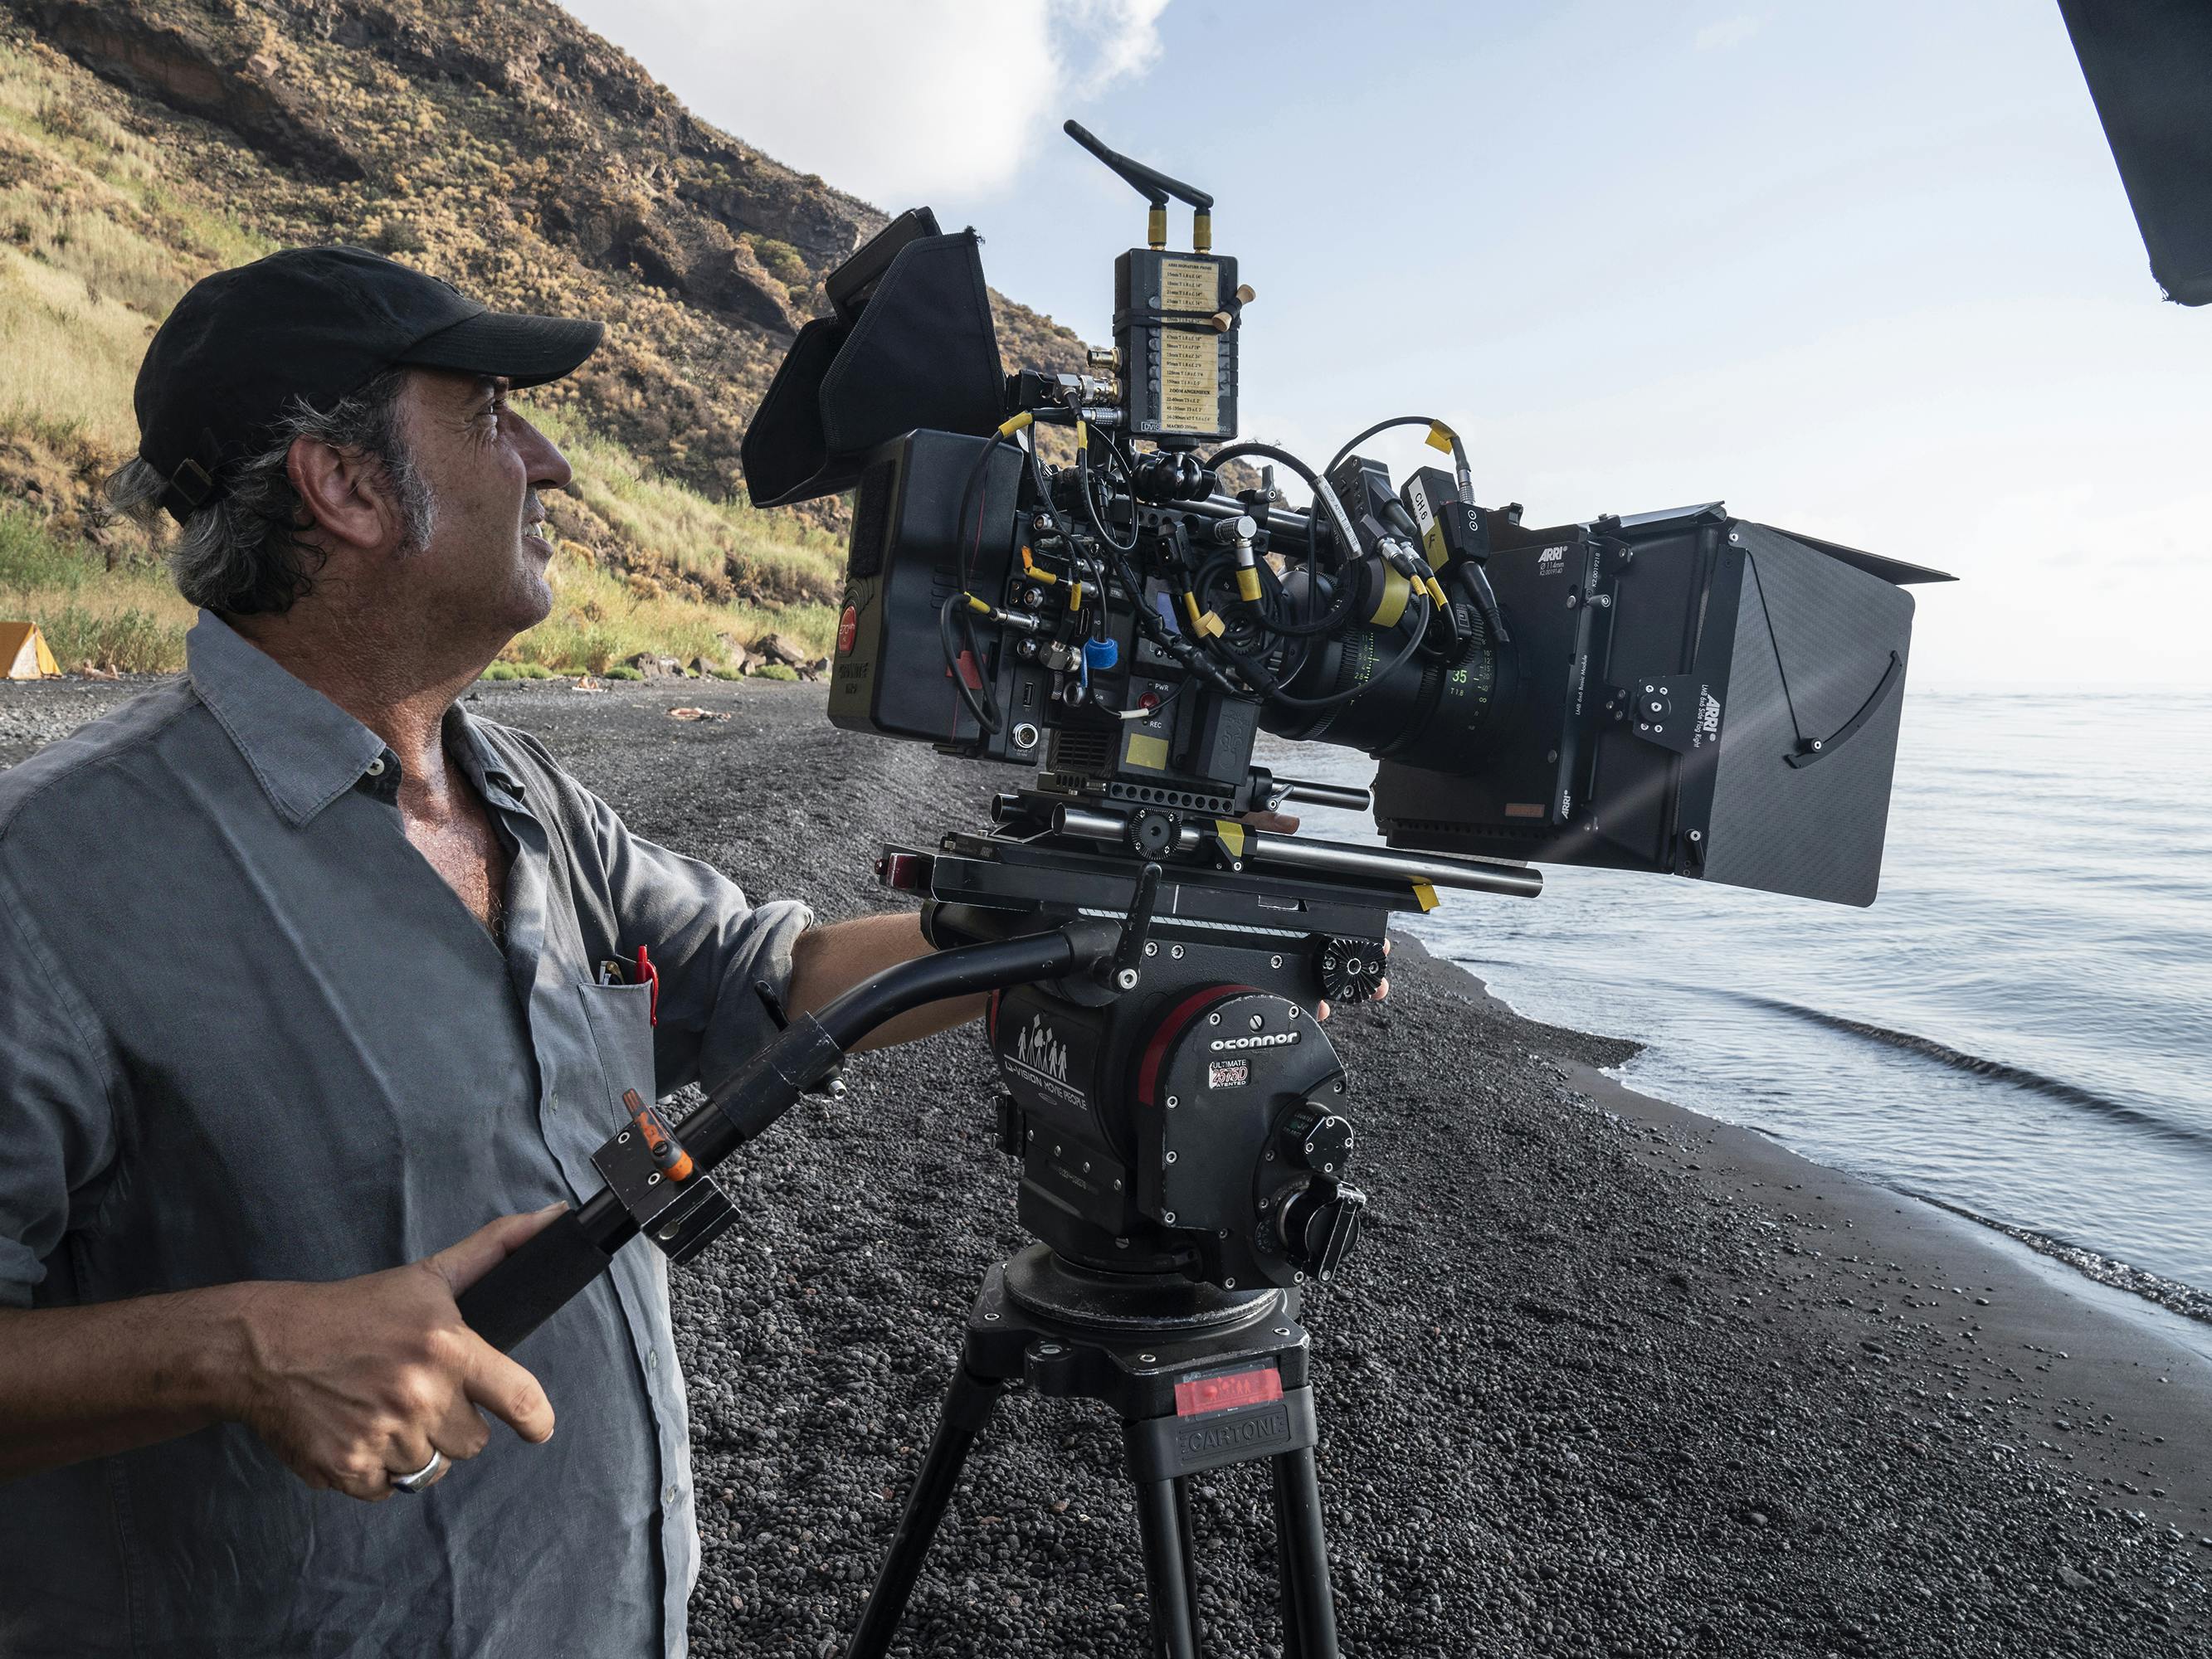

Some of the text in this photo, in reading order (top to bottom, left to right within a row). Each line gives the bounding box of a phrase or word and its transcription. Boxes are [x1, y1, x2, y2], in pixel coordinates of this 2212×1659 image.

[1537, 546, 1563, 563] ARRI
[1452, 669, 1467, 684] 35
[1154, 683, 1169, 692] PWR
[1703, 693, 1721, 732] ARRI
[1149, 721, 1162, 729] REC
[1562, 795, 1571, 820] ARRI
[1210, 1032, 1298, 1051] oconnor
[1212, 1059, 1247, 1069] ULTIMATE
[1212, 1066, 1249, 1083] 2575D
[1062, 1089, 1088, 1112] PEOPLE
[1188, 1418, 1278, 1452] CARTONI
